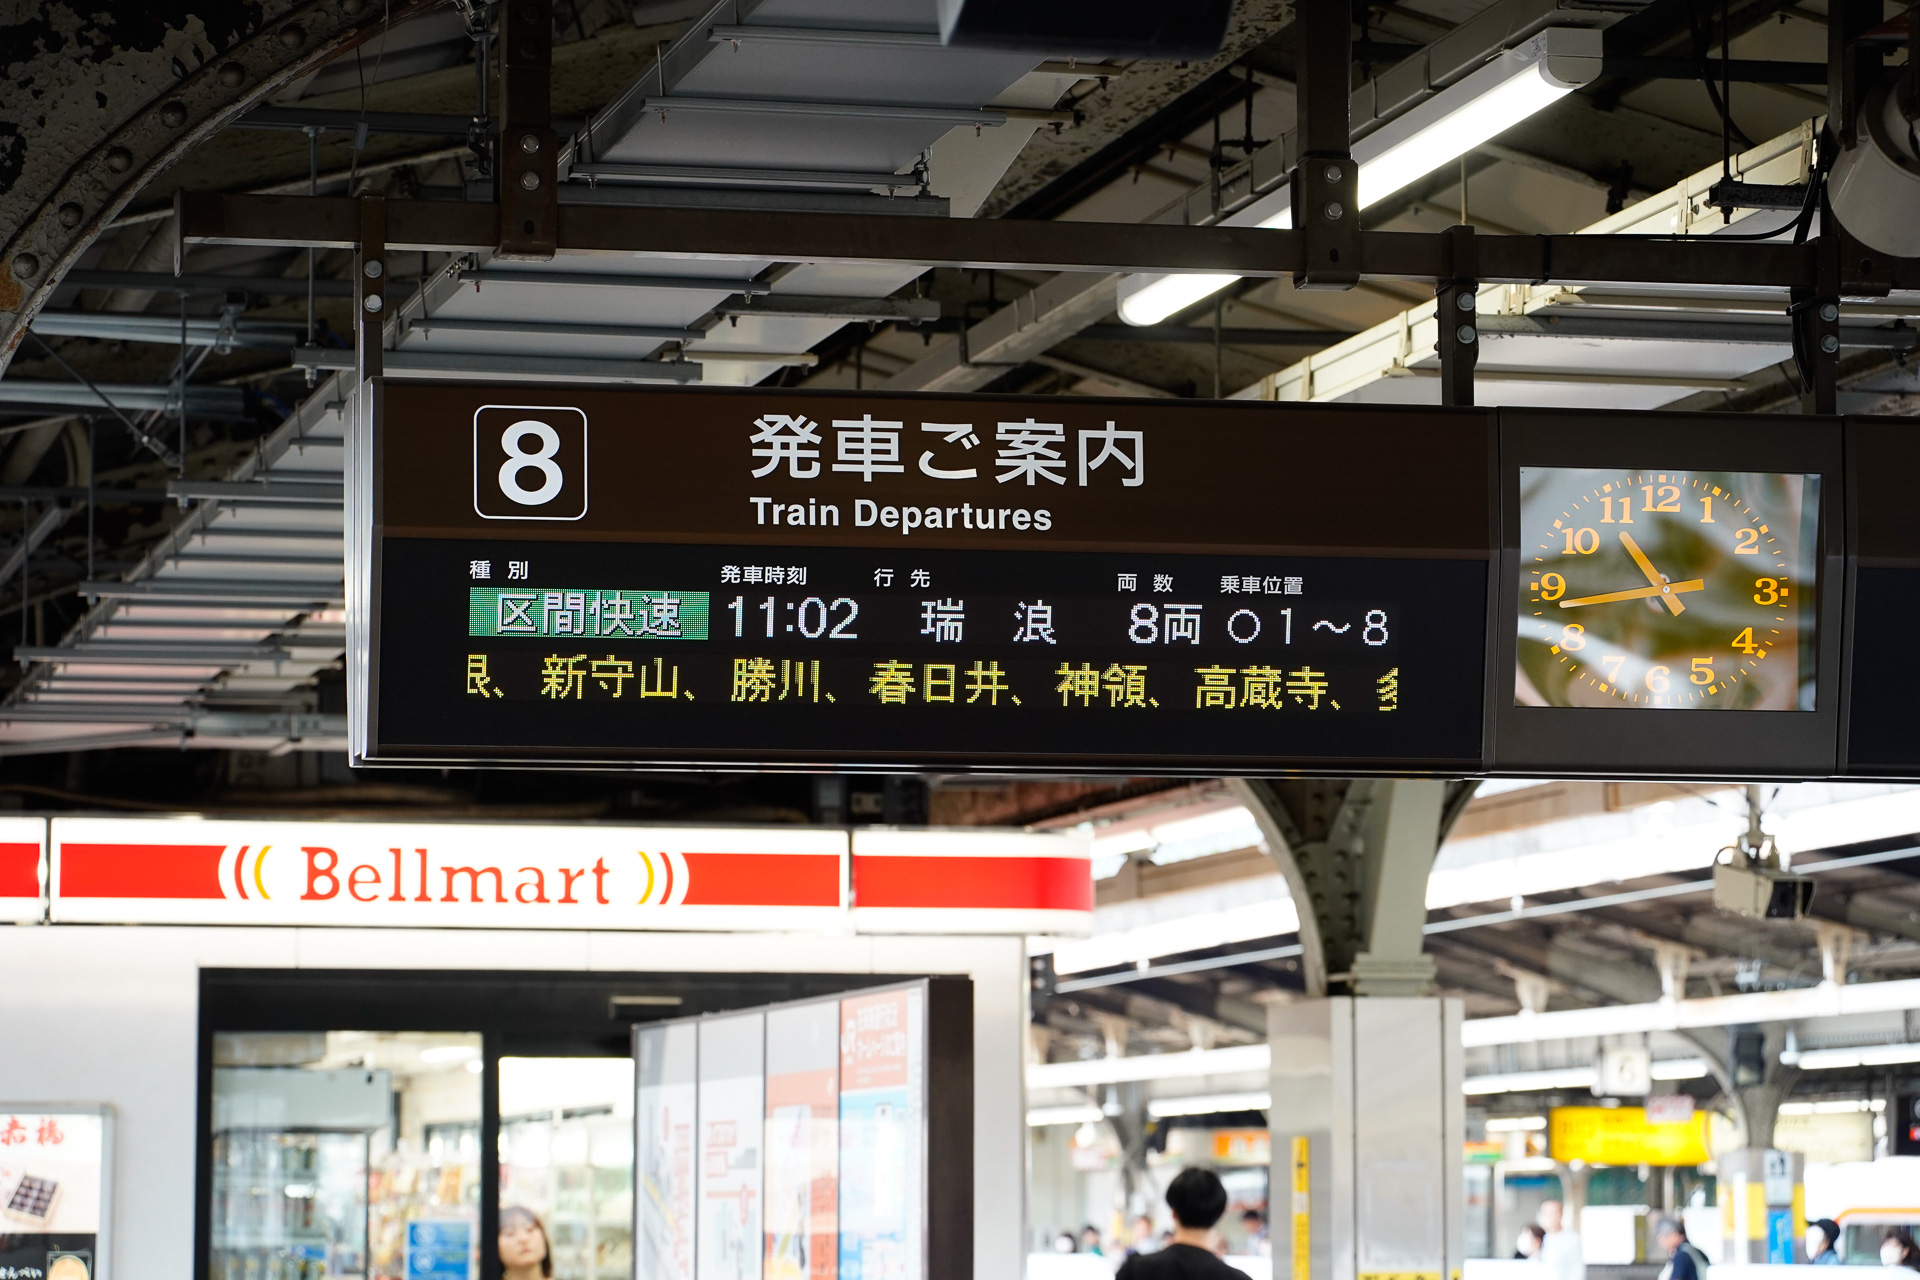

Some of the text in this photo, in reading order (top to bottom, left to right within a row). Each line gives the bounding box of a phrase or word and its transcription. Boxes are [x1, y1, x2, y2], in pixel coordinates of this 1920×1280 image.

[498, 420, 564, 506] 8
[749, 413, 1144, 487] 発車ご案内
[1600, 497, 1634, 523] 11
[1641, 485, 1681, 512] 12
[1700, 497, 1715, 523] 1
[749, 496, 1052, 535] Train Departures
[1561, 528, 1600, 555] 10
[1734, 528, 1759, 555] 2
[720, 564, 807, 586] 発車時刻
[1220, 575, 1304, 595] 乗車位置
[1540, 572, 1567, 601] 9
[1753, 578, 1779, 605] 3
[497, 591, 682, 638] 区間快速
[727, 595, 859, 639] 11:02
[1128, 602, 1203, 645] 8両
[1560, 624, 1587, 651] 8
[1731, 627, 1758, 654] 4
[1602, 656, 1626, 683] 7
[1645, 666, 1670, 693] 6
[1690, 657, 1715, 685] 5
[300, 846, 610, 905] Bellmart
